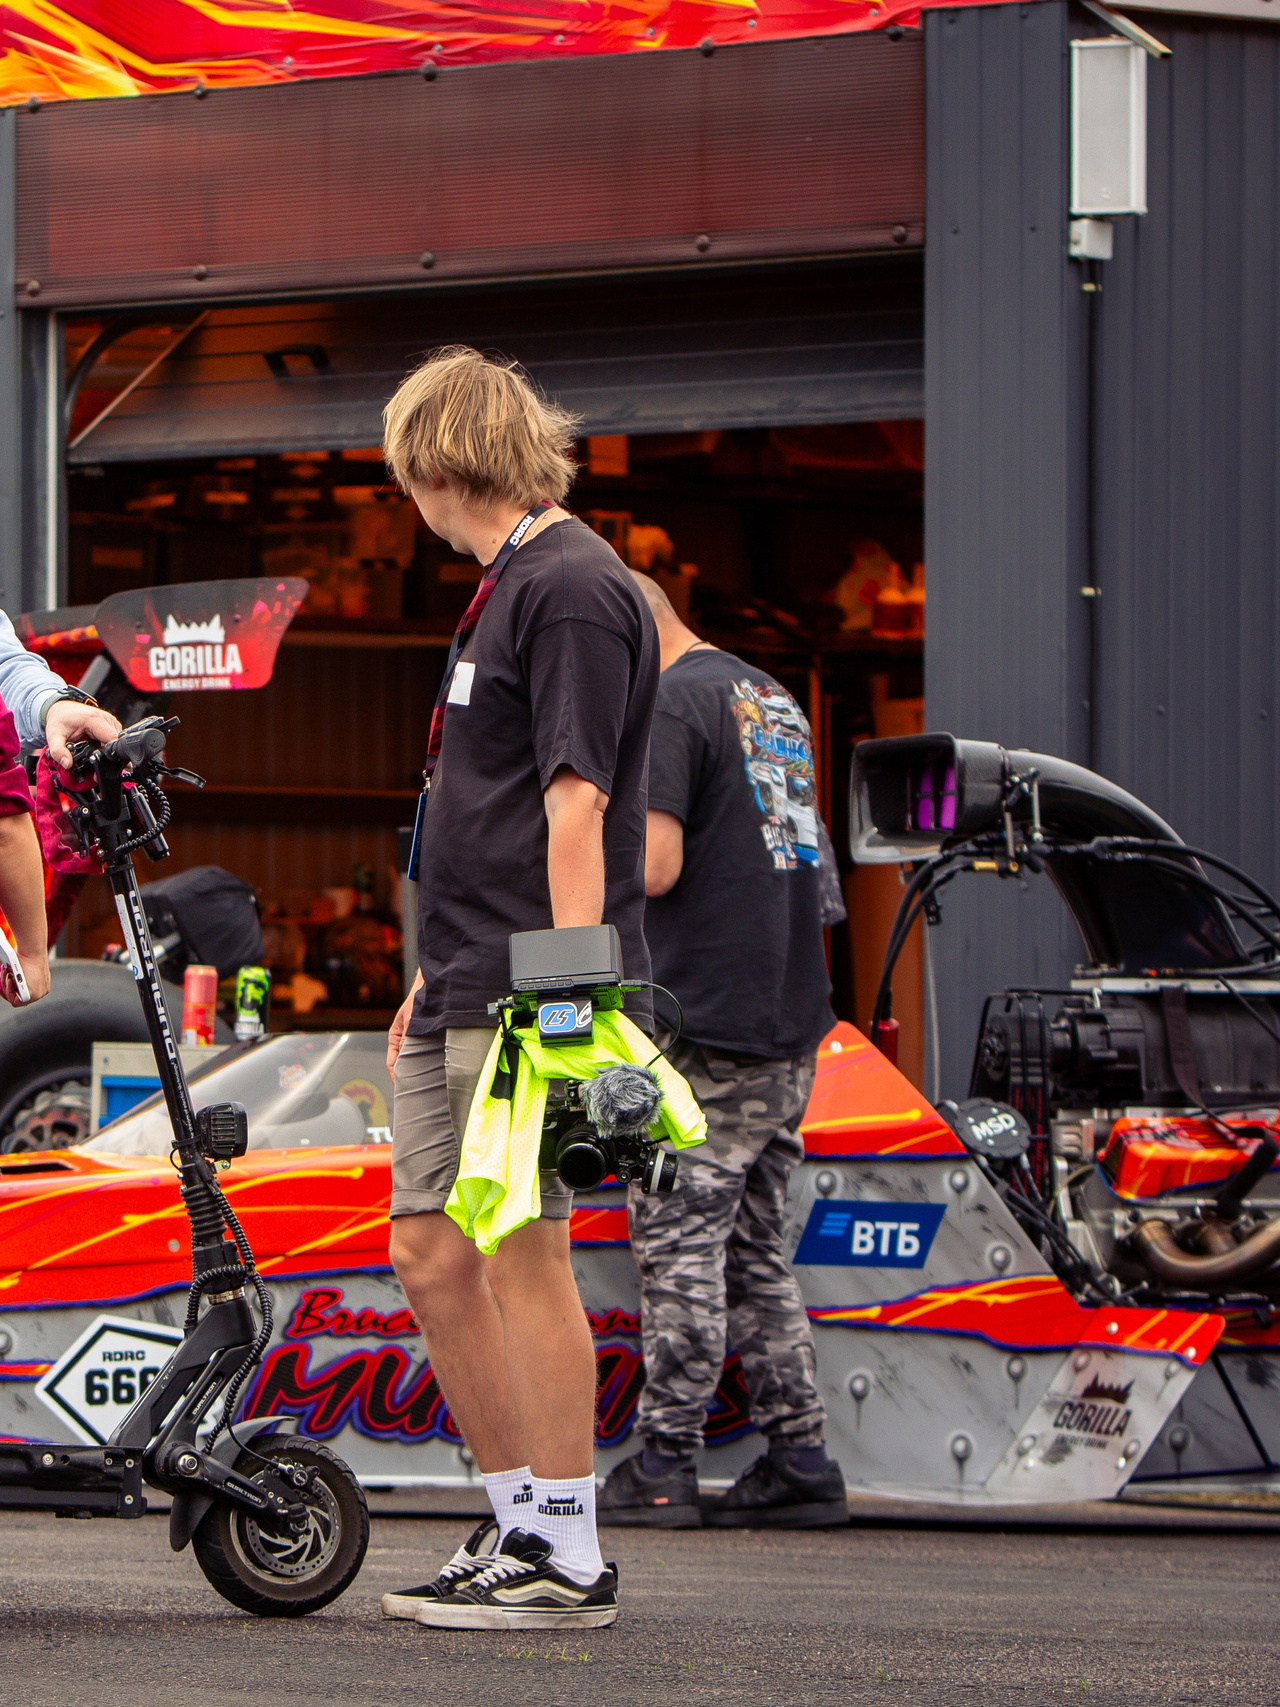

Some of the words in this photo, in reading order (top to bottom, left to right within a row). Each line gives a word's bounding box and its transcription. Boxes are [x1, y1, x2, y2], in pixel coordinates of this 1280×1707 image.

[509, 514, 536, 546] RDRC
[149, 643, 243, 678] GORILLA
[129, 890, 177, 1061] DUALTRON
[543, 1009, 574, 1027] LS
[970, 1112, 1017, 1142] MSD
[851, 1220, 921, 1257] ВТБ
[291, 1288, 420, 1335] Bruc
[102, 1350, 147, 1363] RDRC
[191, 1380, 217, 1416] DUALTRON
[1053, 1400, 1132, 1438] GORILLA
[226, 1480, 262, 1504] DUALTRON
[538, 1503, 584, 1516] GORILLA
